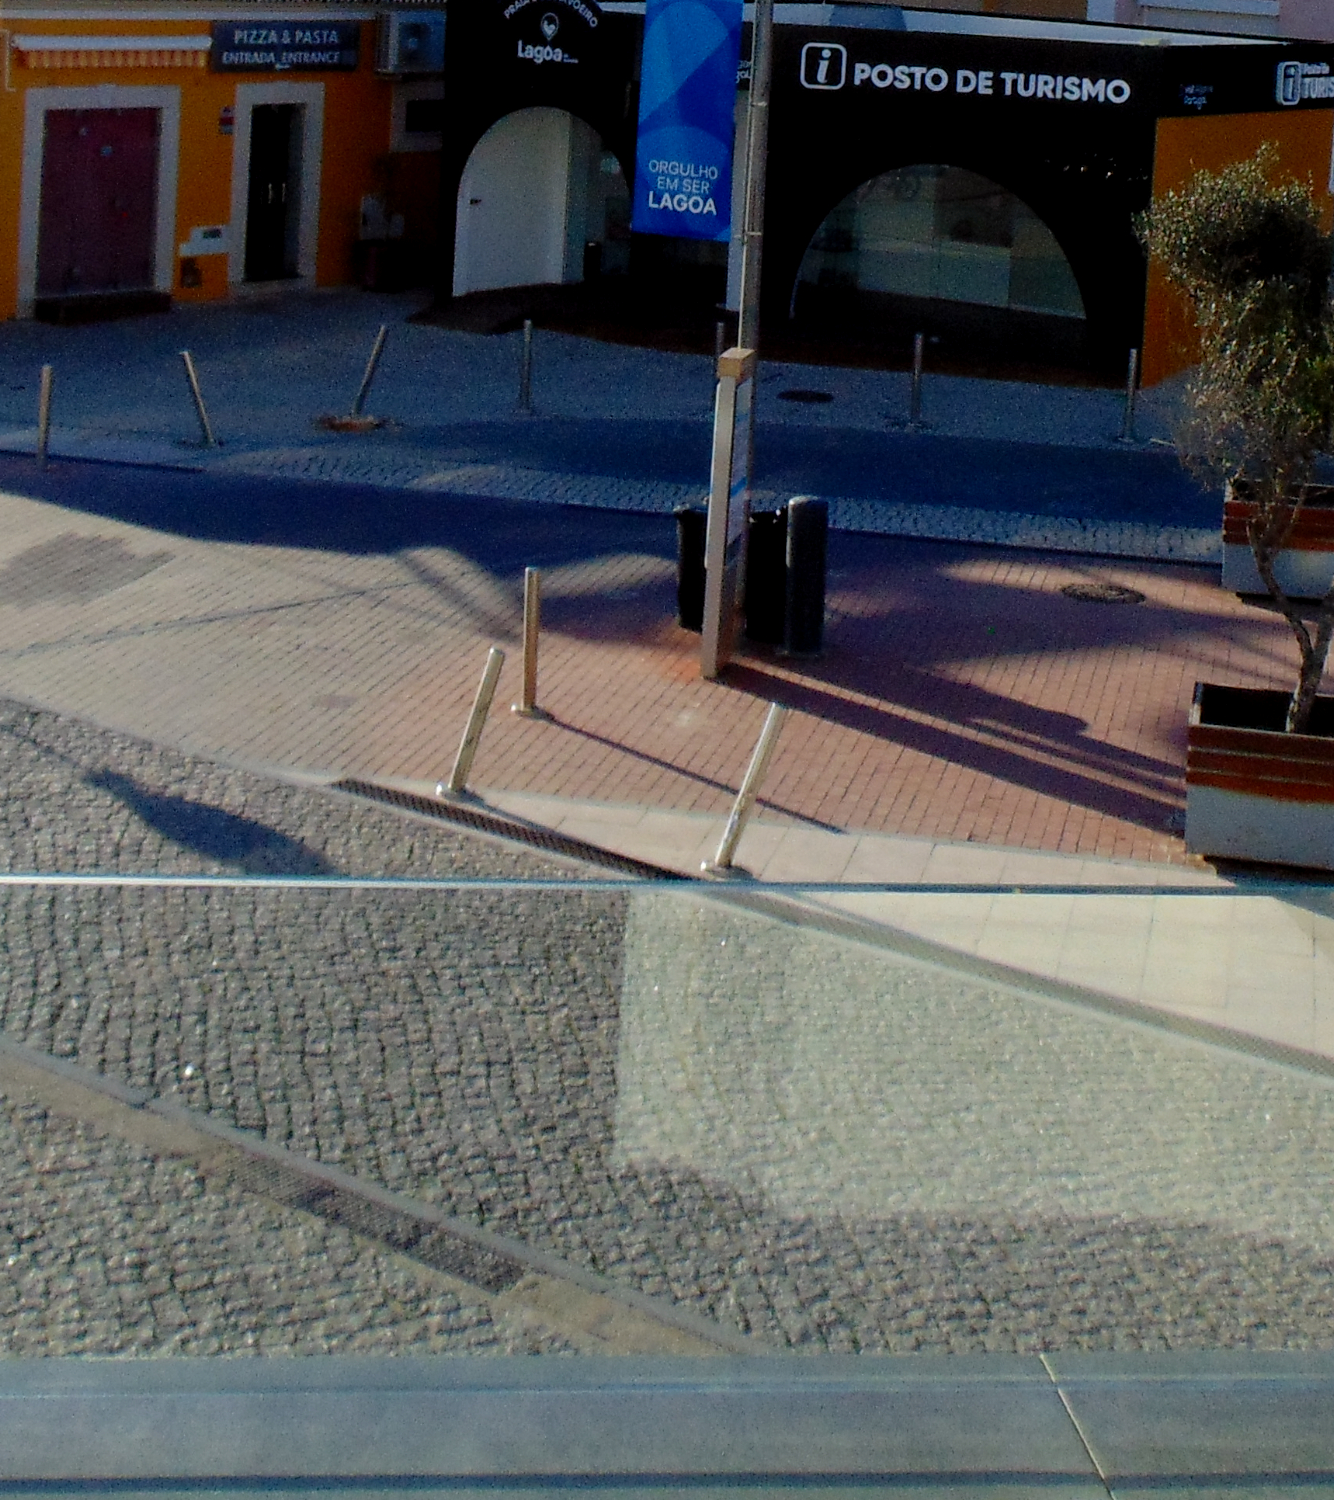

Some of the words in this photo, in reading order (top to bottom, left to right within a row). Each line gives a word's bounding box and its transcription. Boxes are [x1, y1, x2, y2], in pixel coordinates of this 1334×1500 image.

[233, 29, 279, 45] PIZZA
[281, 29, 292, 45] &
[295, 29, 339, 45] PASTA
[222, 51, 276, 65] ENTRADA
[280, 51, 341, 65] ENTRANCE
[517, 40, 563, 64] Lagoa
[854, 62, 949, 92] POSTO
[956, 69, 995, 96] DE
[1000, 71, 1132, 104] TURISMO
[648, 159, 719, 180] ORGULHO
[657, 176, 679, 191] EM
[682, 179, 711, 195] SER
[648, 191, 718, 217] LAGOA
